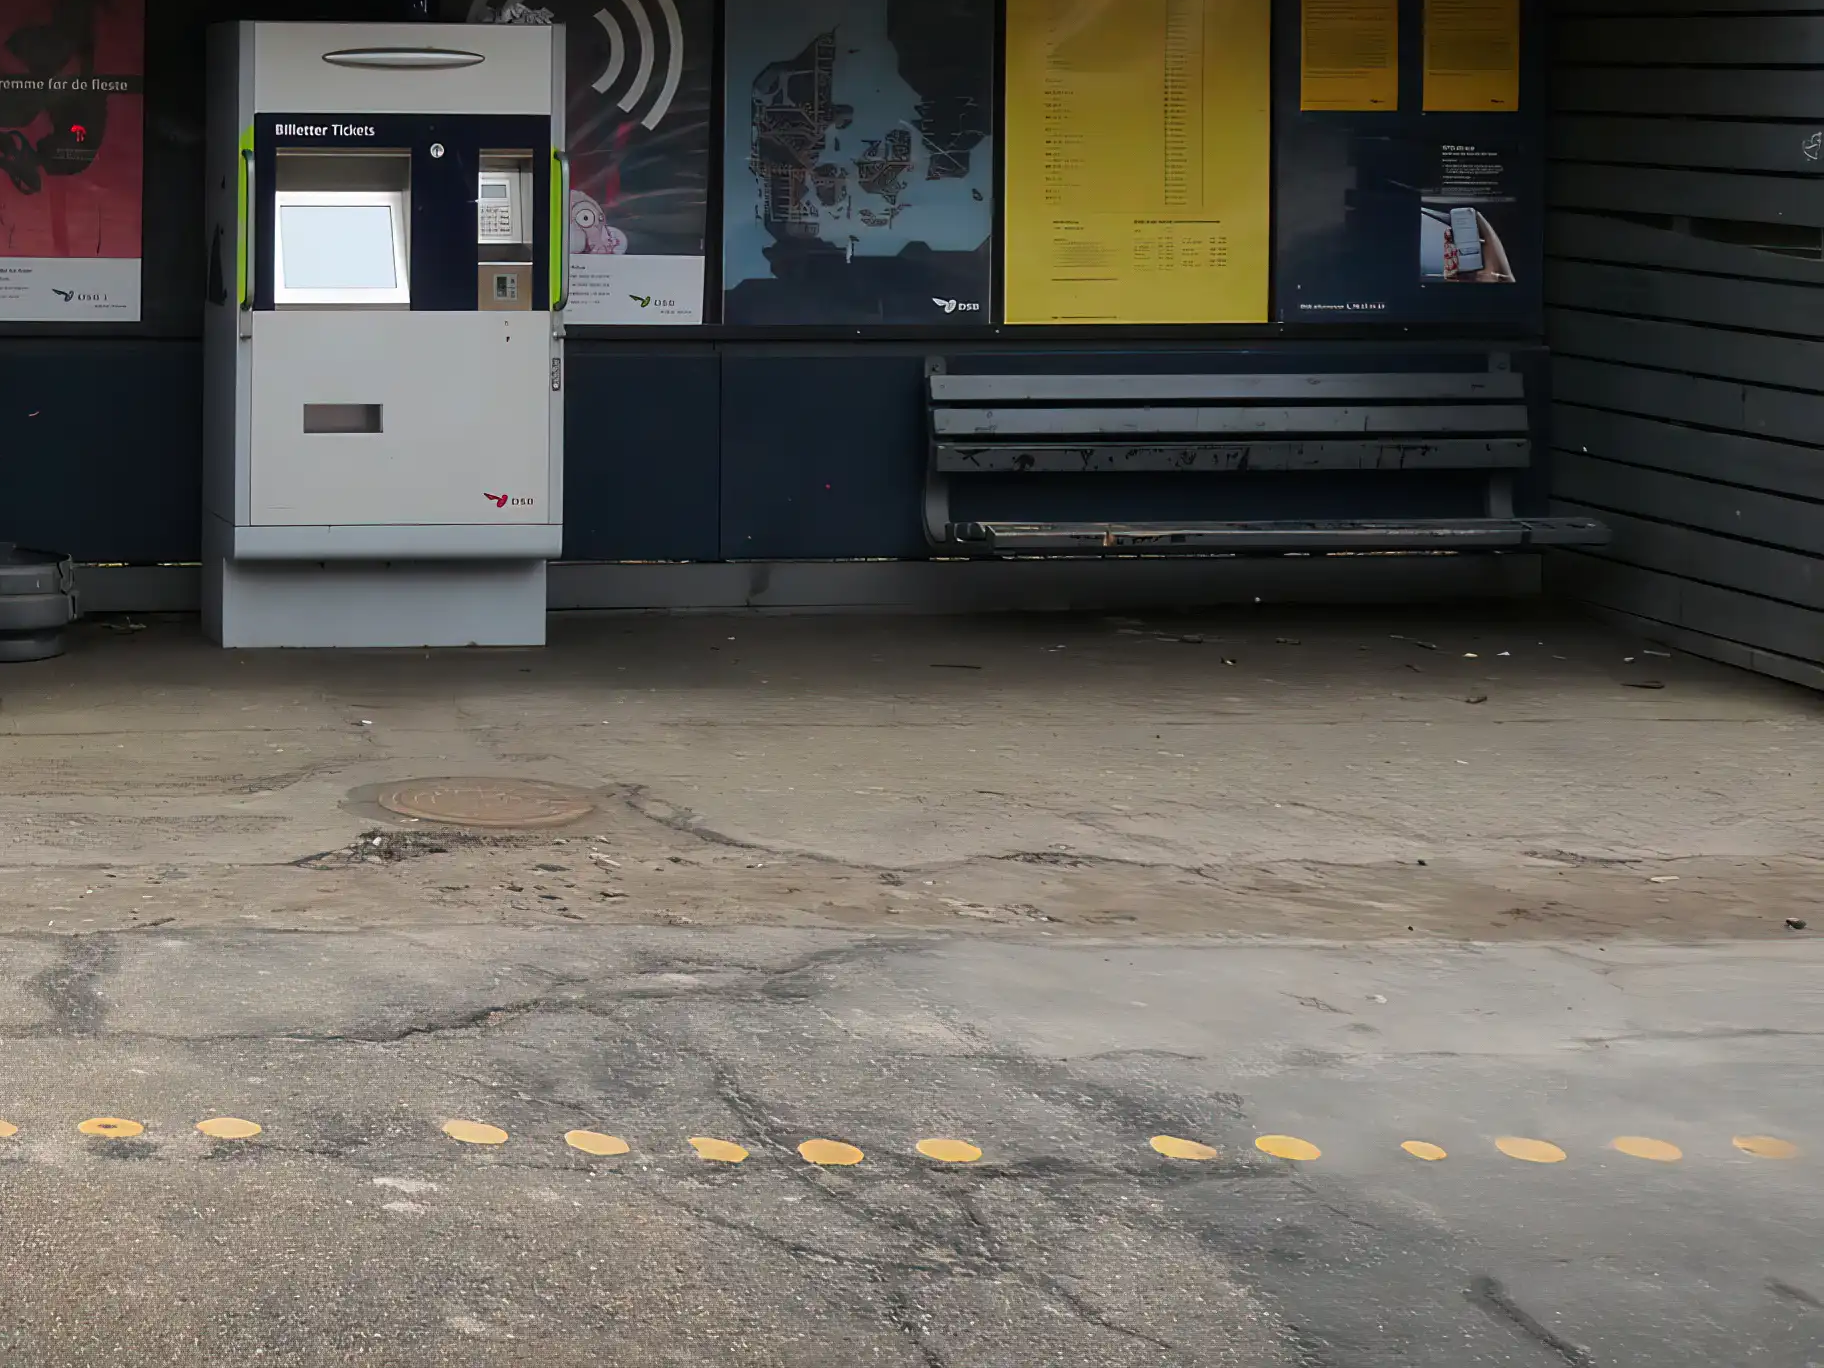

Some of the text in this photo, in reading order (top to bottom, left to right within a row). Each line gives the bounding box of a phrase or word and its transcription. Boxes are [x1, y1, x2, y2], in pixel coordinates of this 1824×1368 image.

[275, 124, 376, 137] Billetter Tickets
[958, 303, 980, 311] DSB
